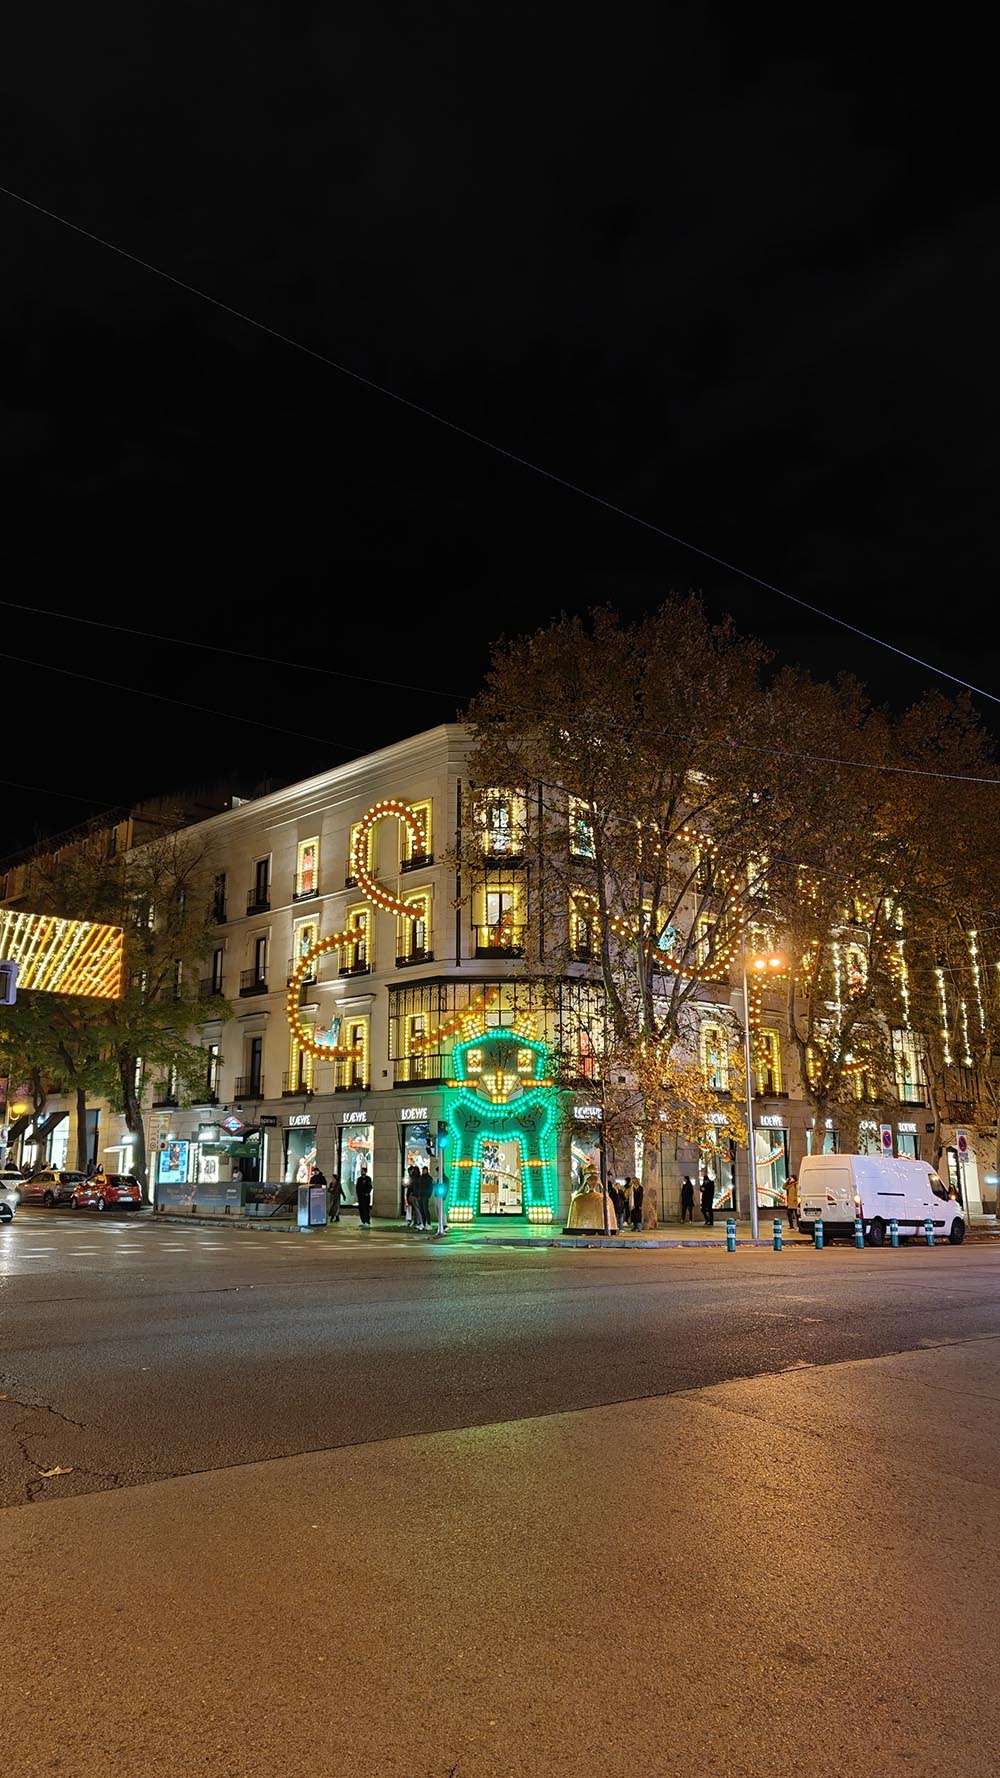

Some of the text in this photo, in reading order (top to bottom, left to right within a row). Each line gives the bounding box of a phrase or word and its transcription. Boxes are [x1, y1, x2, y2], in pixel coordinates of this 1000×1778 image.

[343, 1111, 367, 1123] LOEWE
[401, 1107, 428, 1120] LOEWE
[289, 1114, 311, 1126] LOEWE
[760, 1115, 784, 1126] LOEWE
